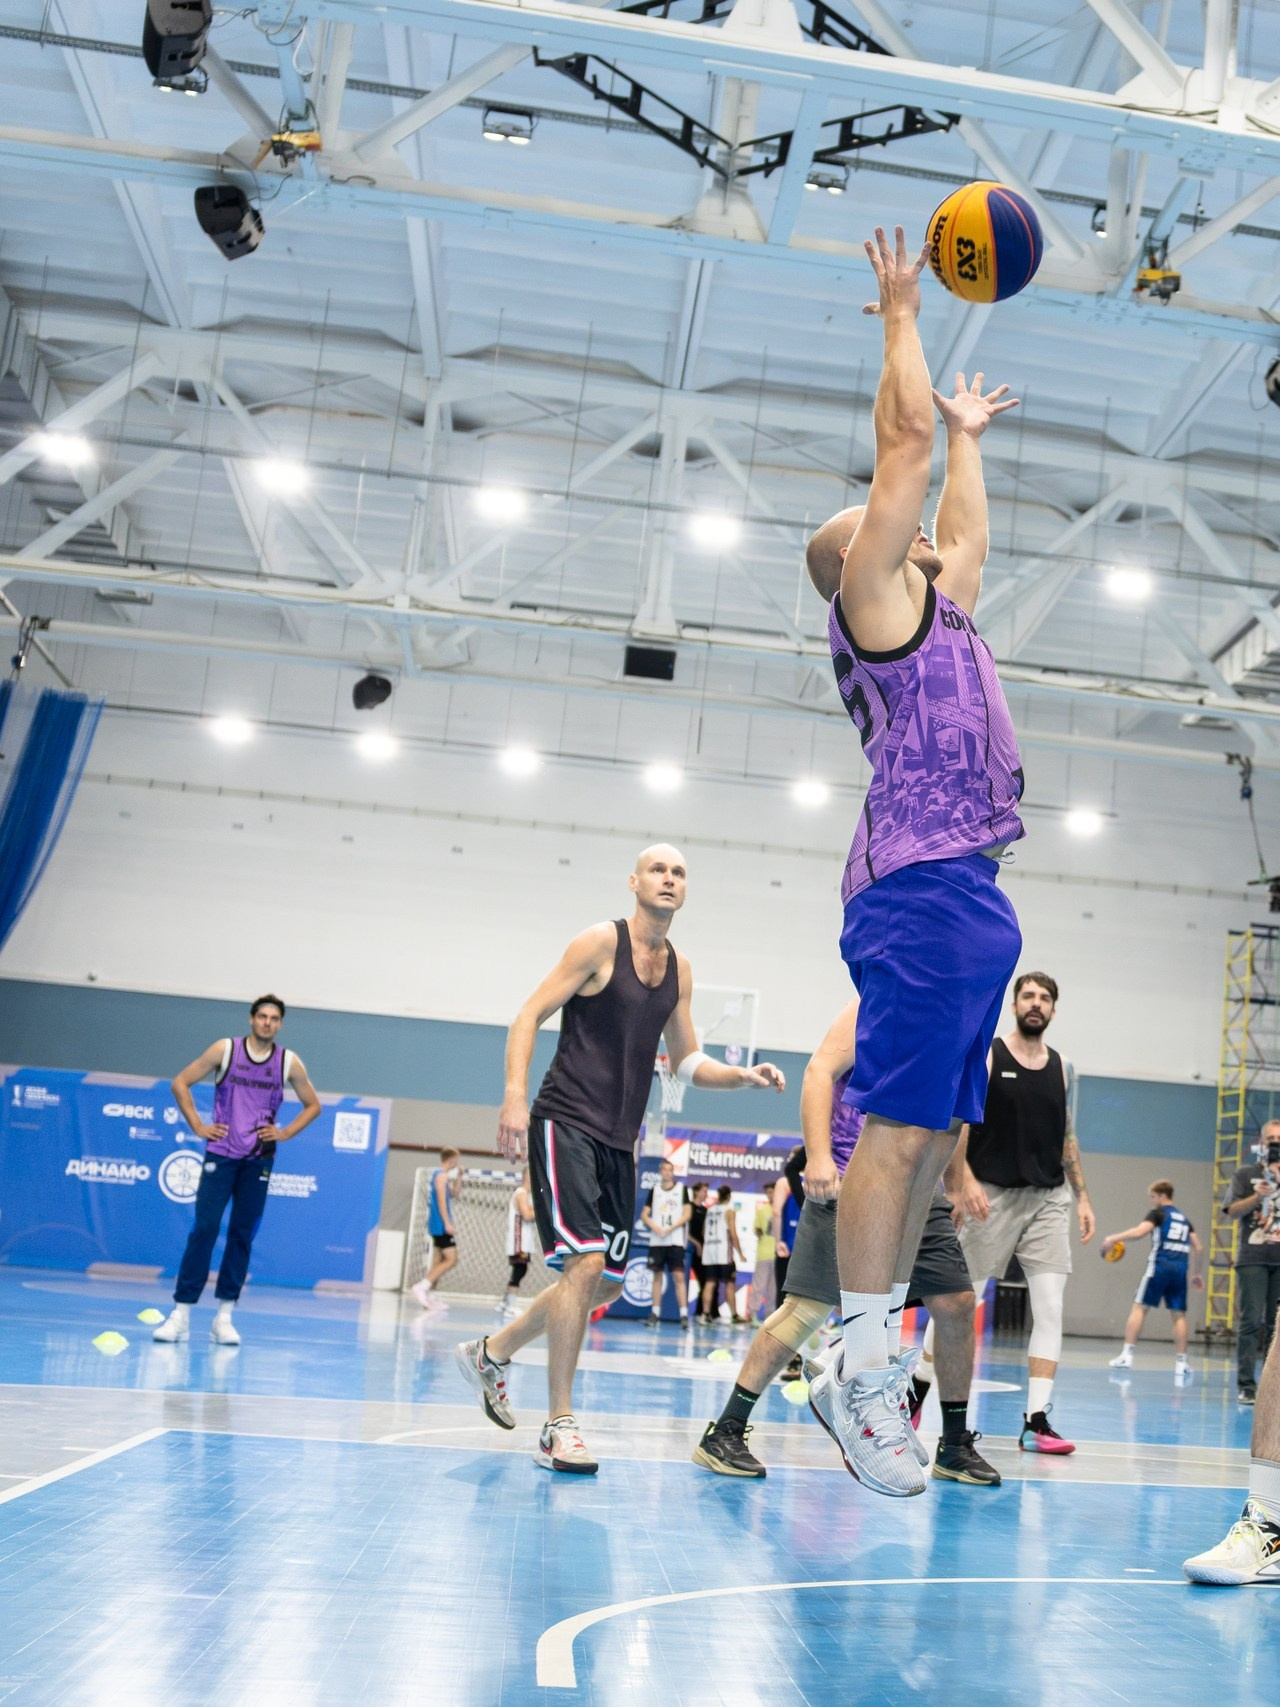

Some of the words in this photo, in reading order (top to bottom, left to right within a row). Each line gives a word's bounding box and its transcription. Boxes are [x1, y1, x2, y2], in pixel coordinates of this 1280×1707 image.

[65, 1160, 151, 1181] ДИНАМО
[689, 1150, 784, 1172] ЧЕМПИОНАТ
[1166, 1221, 1190, 1242] 21
